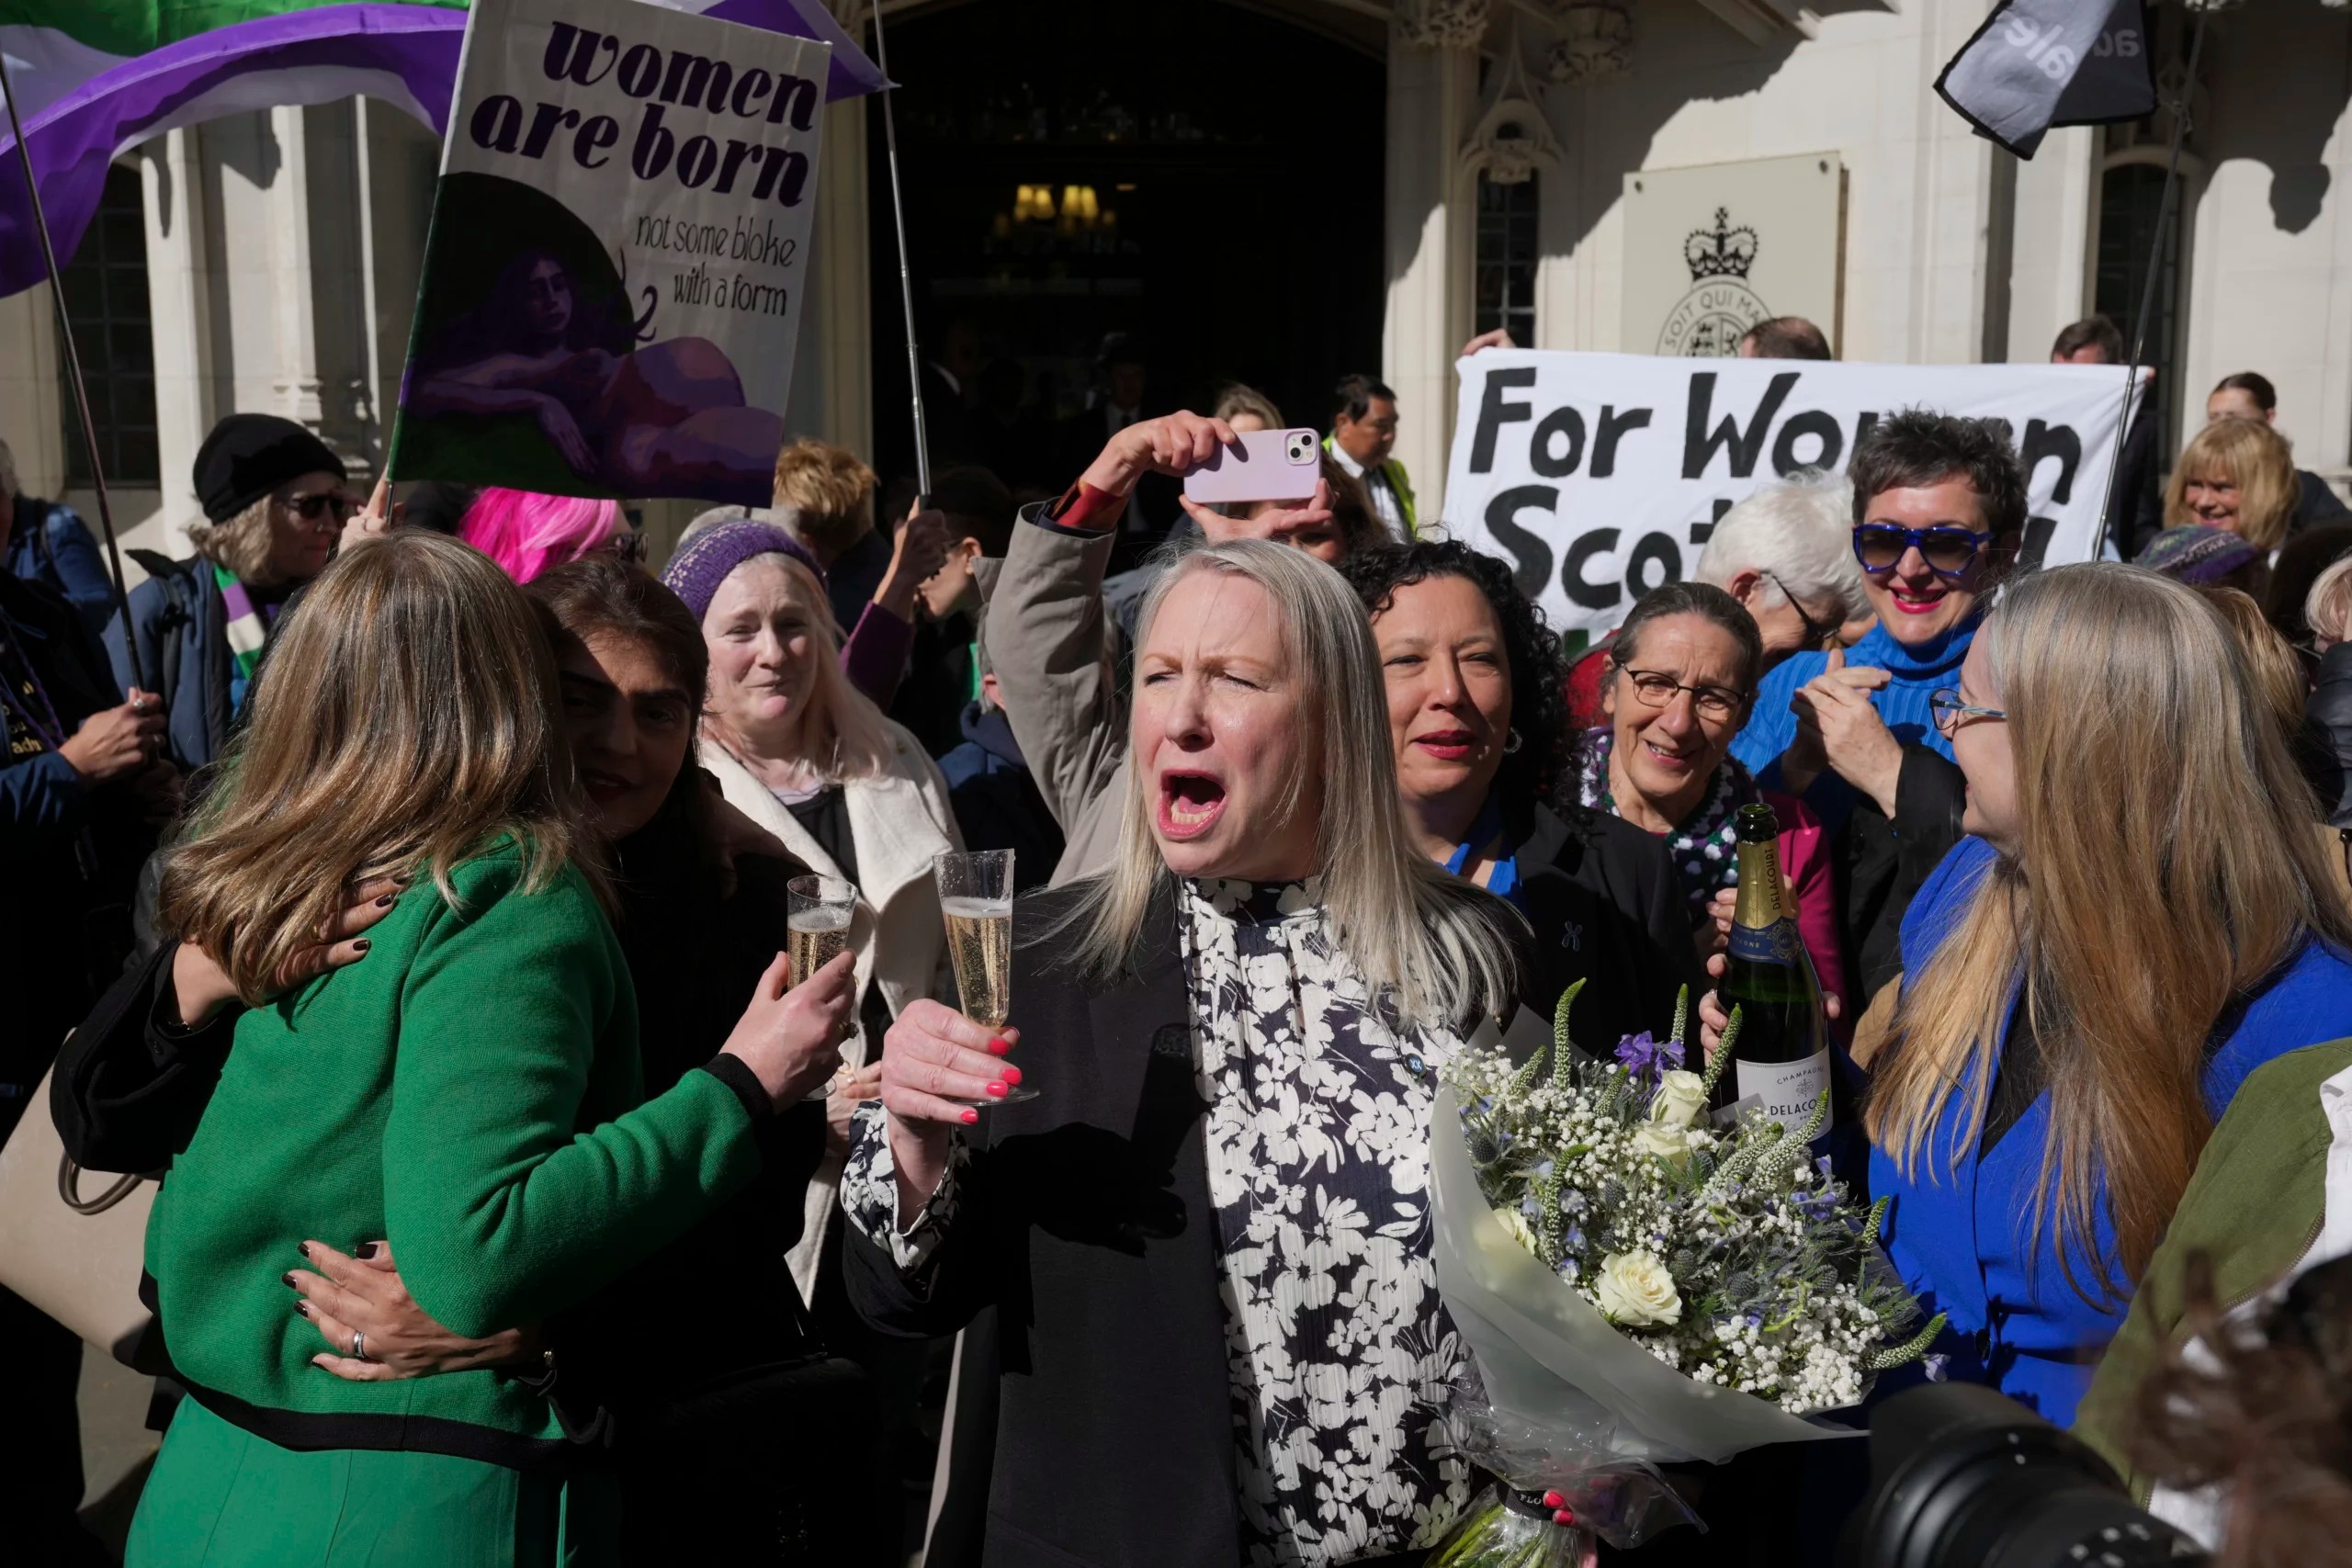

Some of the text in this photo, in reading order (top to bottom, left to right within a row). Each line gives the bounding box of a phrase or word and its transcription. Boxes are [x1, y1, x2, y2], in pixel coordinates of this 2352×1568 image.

[544, 21, 818, 131] women
[470, 95, 809, 208] are born
[636, 214, 796, 267] not some bloke
[673, 261, 787, 316] with a form
[1665, 302, 1694, 347] SOIT
[1700, 290, 1733, 310] QUI
[1470, 367, 2081, 505] For Won
[1765, 849, 1781, 909] DELACOURT
